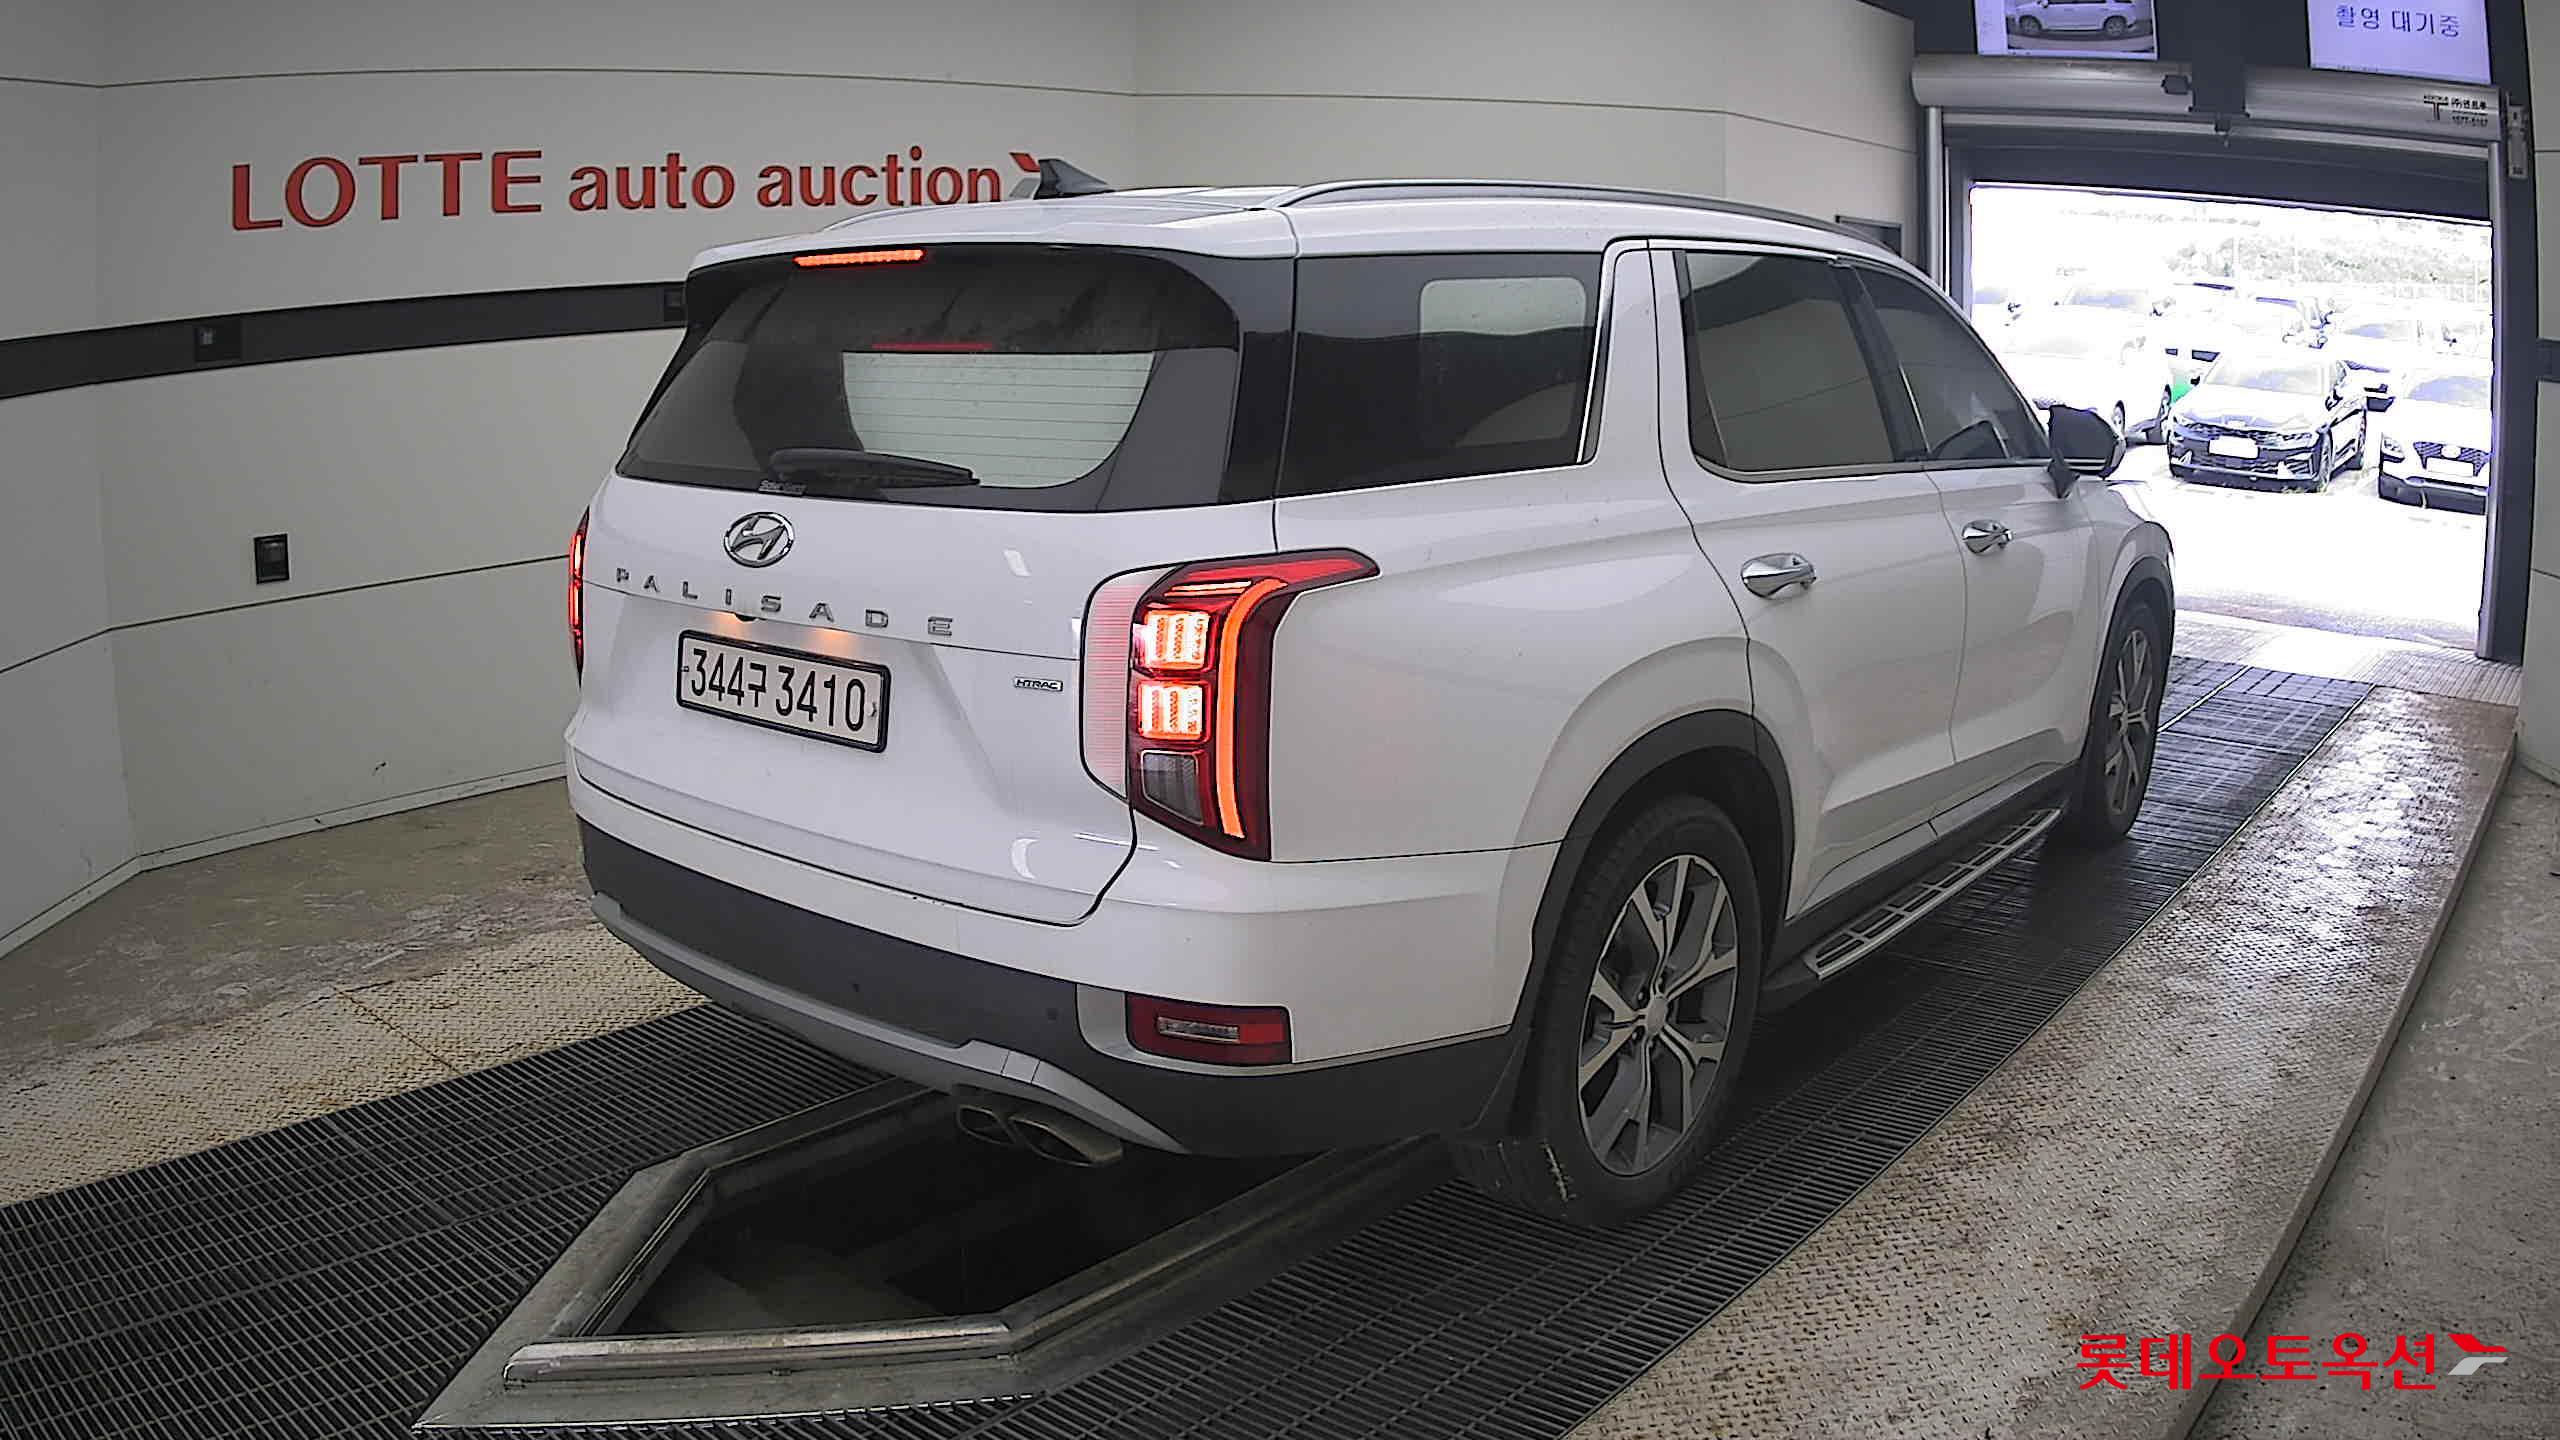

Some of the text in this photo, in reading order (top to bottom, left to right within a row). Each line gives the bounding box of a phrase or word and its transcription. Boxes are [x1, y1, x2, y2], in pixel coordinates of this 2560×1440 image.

[2337, 6, 2460, 38] 촬영 대기중
[233, 147, 1001, 231] LOTTE auto auction
[615, 567, 953, 637] PALISADE
[691, 648, 865, 732] 344구 3410
[1016, 679, 1059, 690] HTRAC
